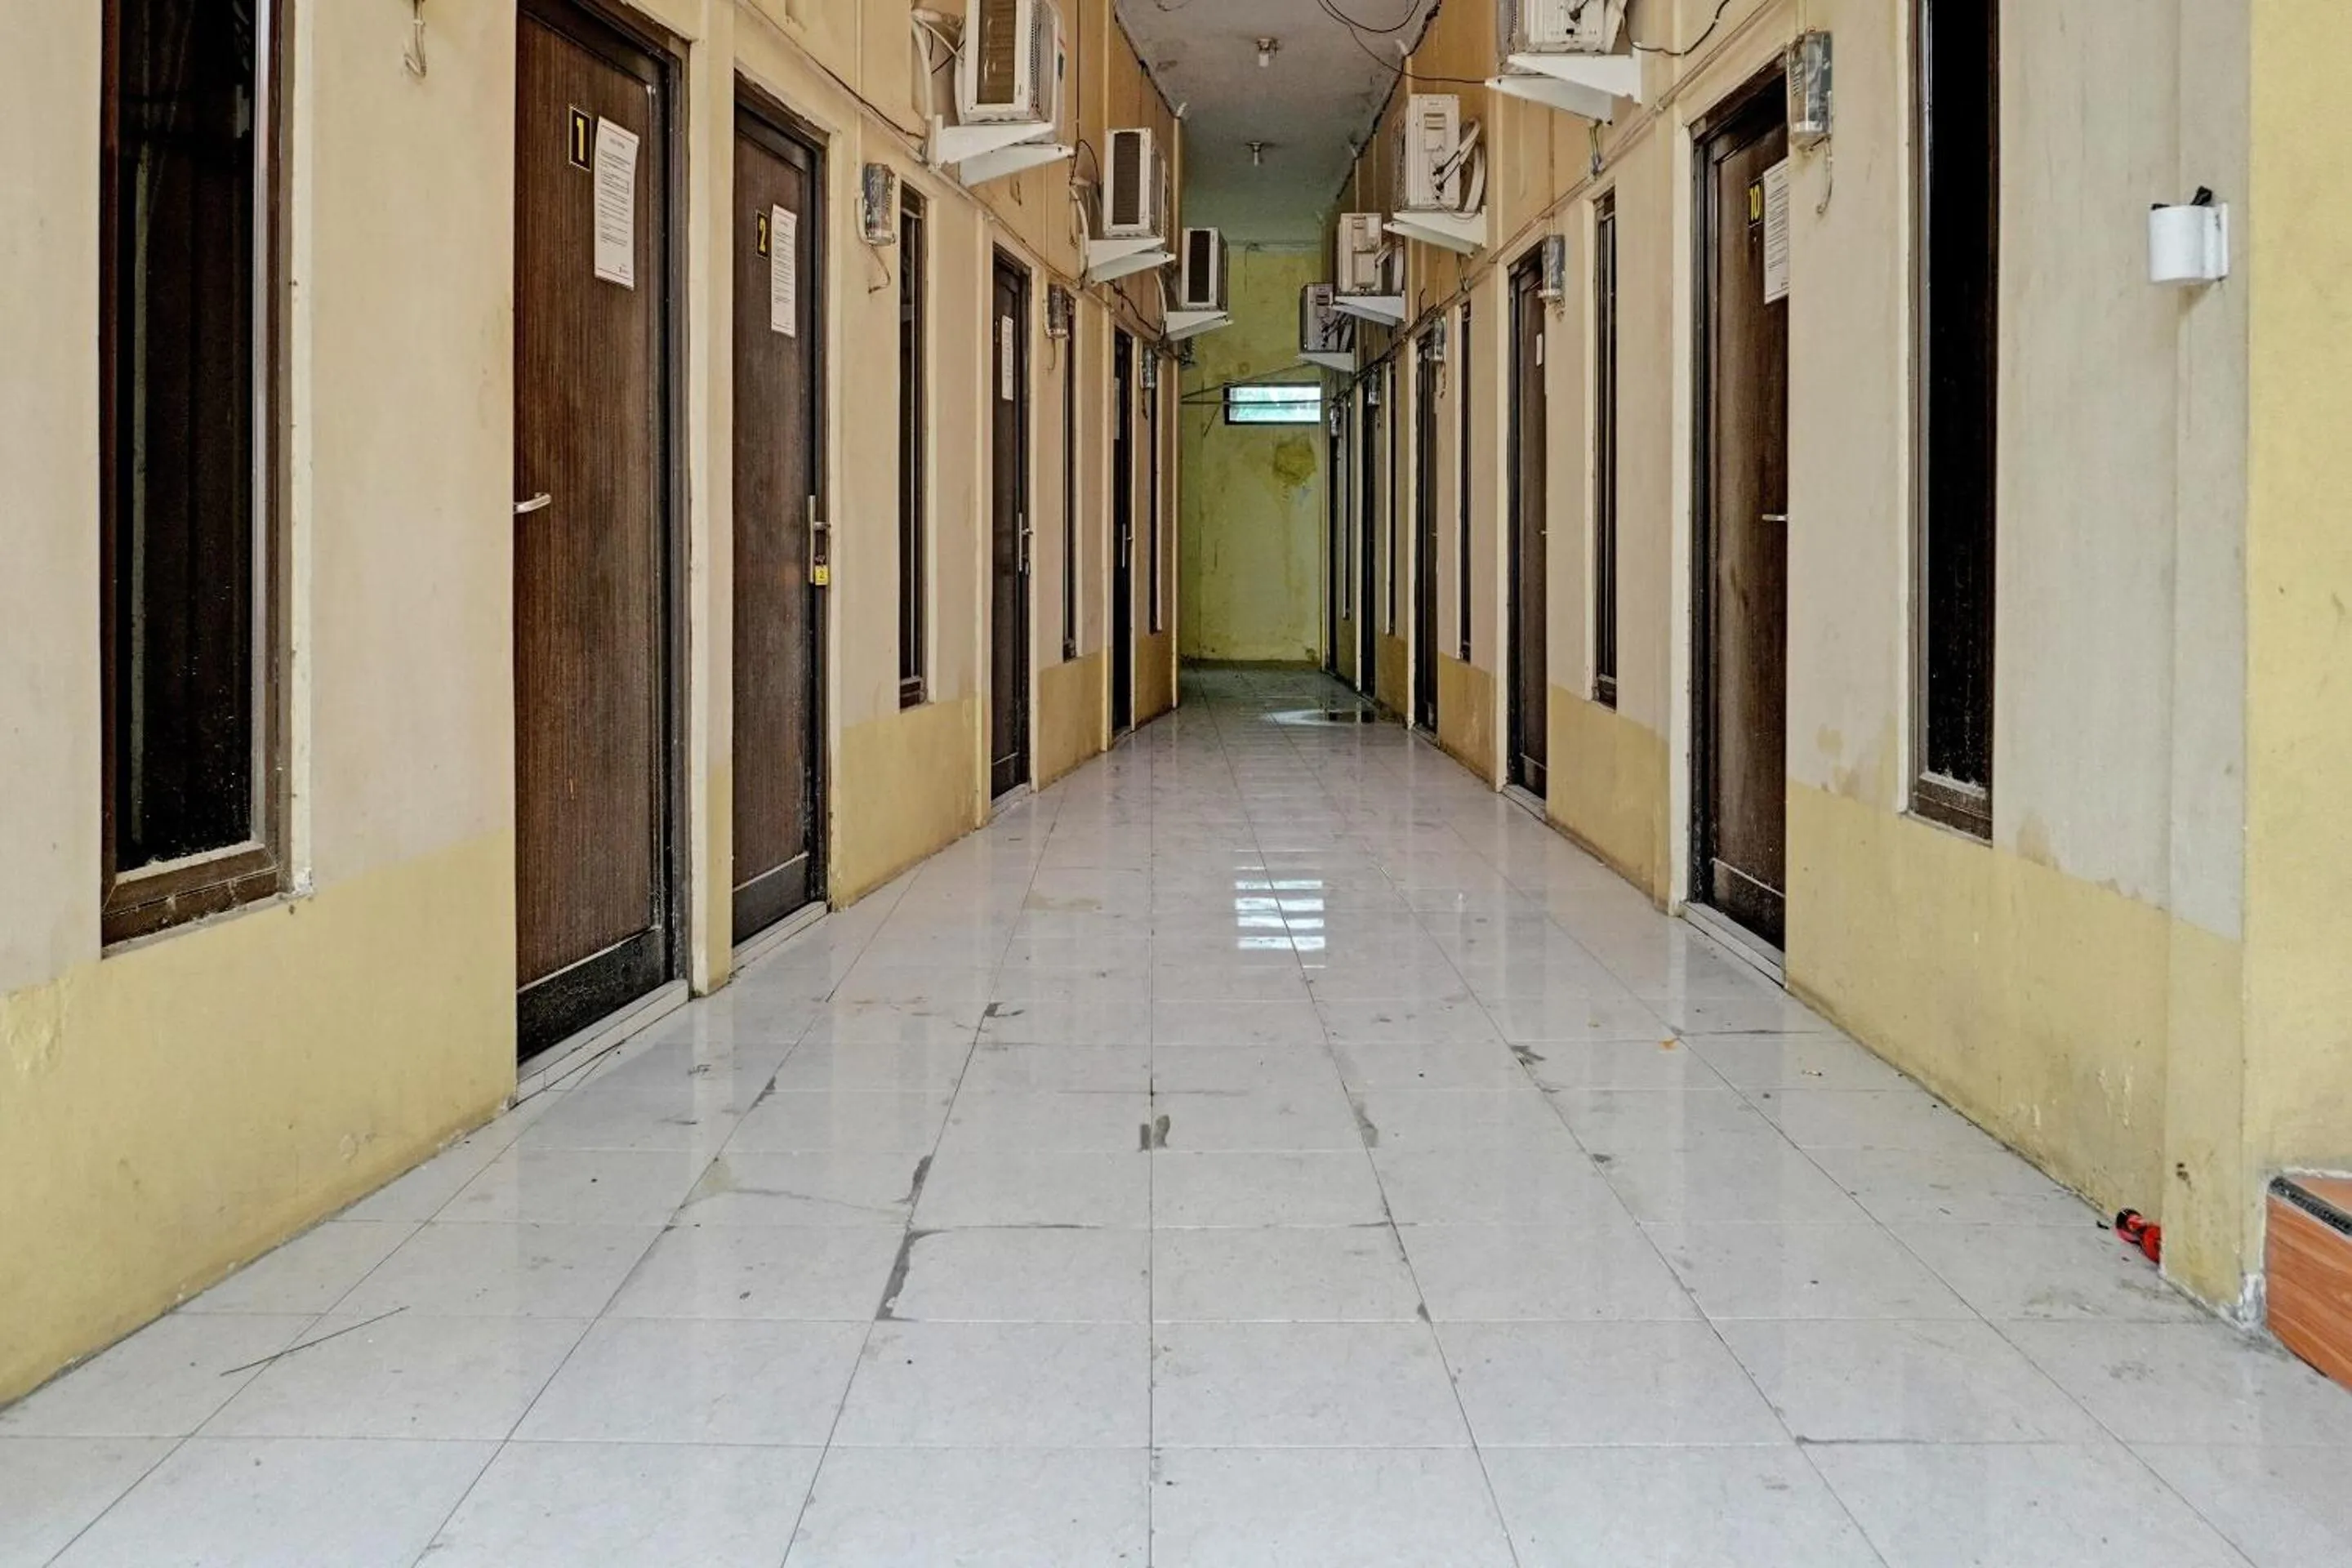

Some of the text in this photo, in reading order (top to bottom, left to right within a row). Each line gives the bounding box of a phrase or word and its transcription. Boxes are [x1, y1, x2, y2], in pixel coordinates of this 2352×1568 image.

[577, 117, 584, 162] 1
[1749, 185, 1760, 220] 10
[759, 217, 766, 252] 2
